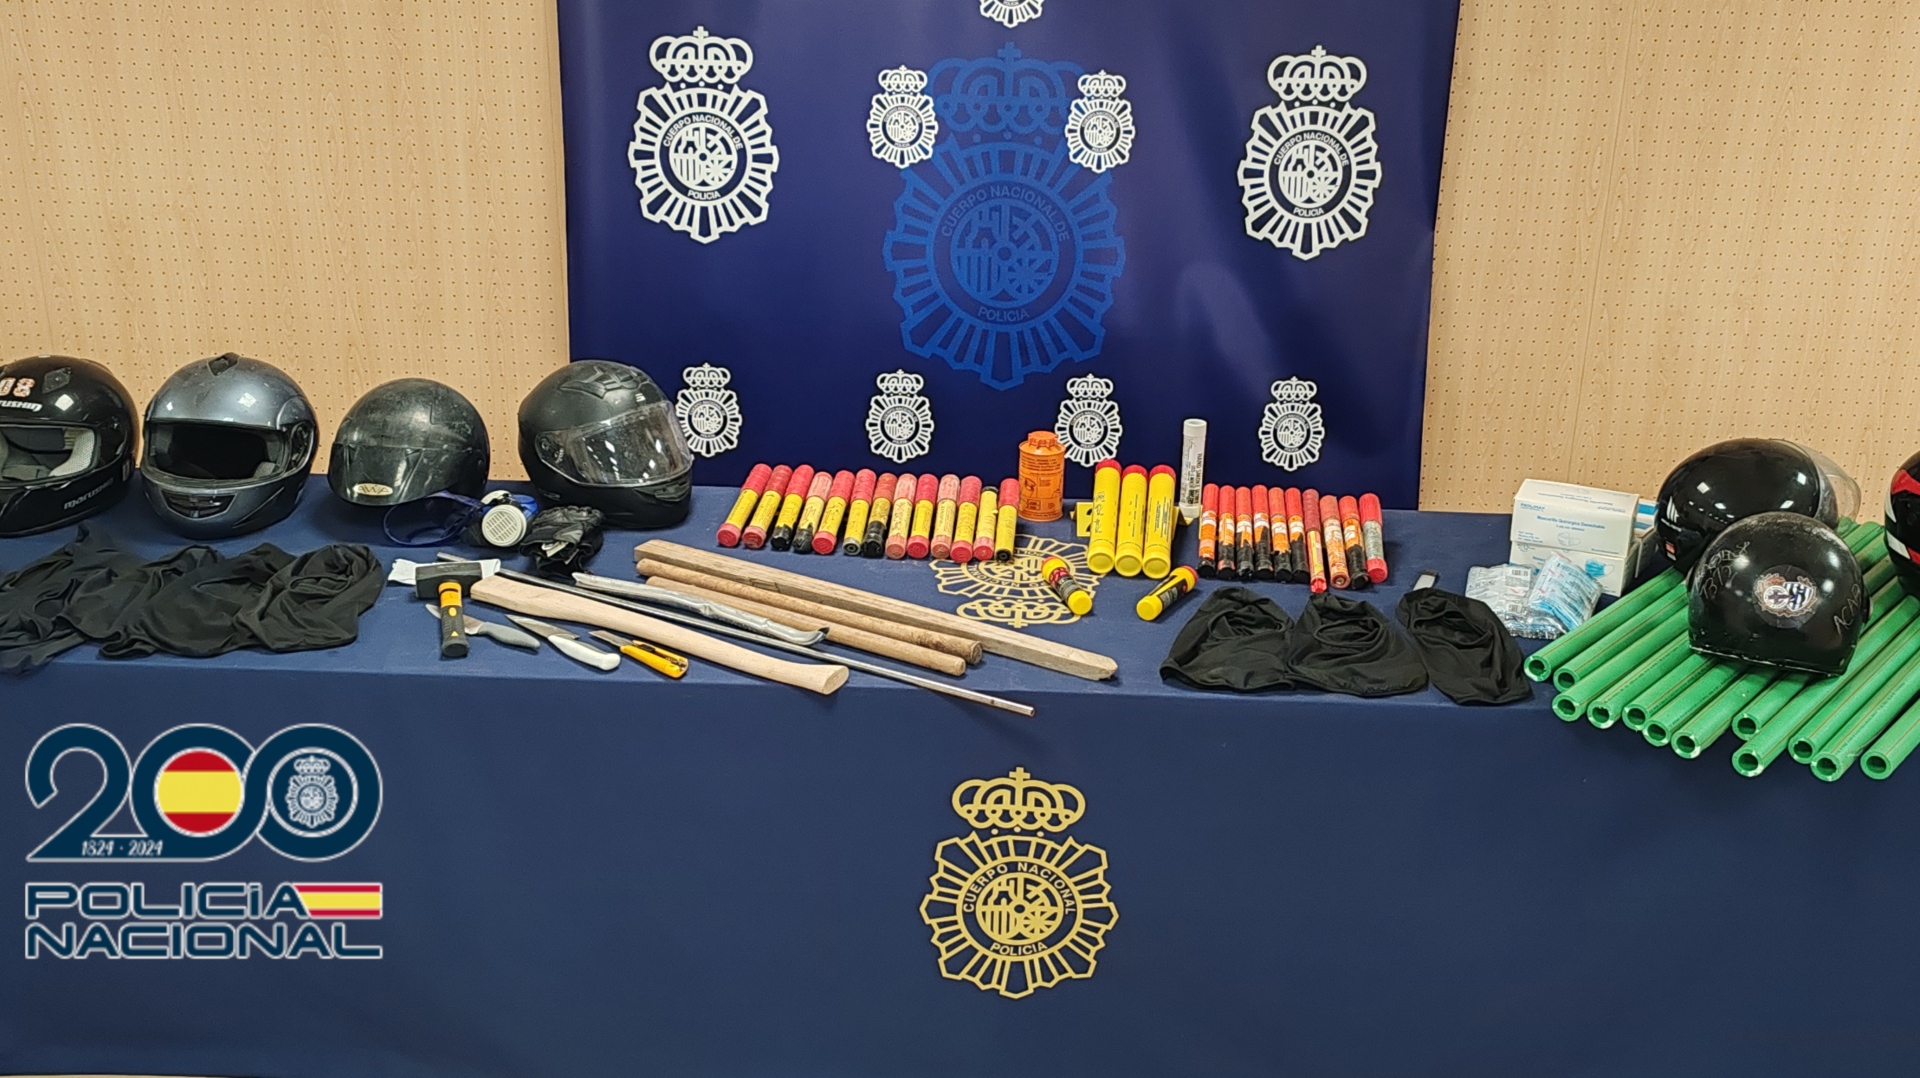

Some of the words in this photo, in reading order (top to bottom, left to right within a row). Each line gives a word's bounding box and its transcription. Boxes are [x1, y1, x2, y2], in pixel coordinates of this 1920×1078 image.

[663, 117, 691, 147] CUERPO
[692, 114, 733, 137] NACIONAL
[732, 135, 743, 150] DE
[1273, 134, 1302, 165] CUERPO
[1303, 132, 1342, 154] NACIONAL
[1340, 153, 1349, 166] DE
[687, 190, 721, 200] POLICIA
[941, 189, 987, 237] CUERPO
[990, 185, 1059, 222] NACIONAL
[1054, 219, 1070, 242] DE
[1293, 207, 1324, 217] POLICIA
[977, 306, 1030, 322] POLICIA
[963, 863, 1008, 913] CUERPO
[1017, 862, 1076, 915] NACIONAL
[989, 941, 1048, 956] POLICIA
